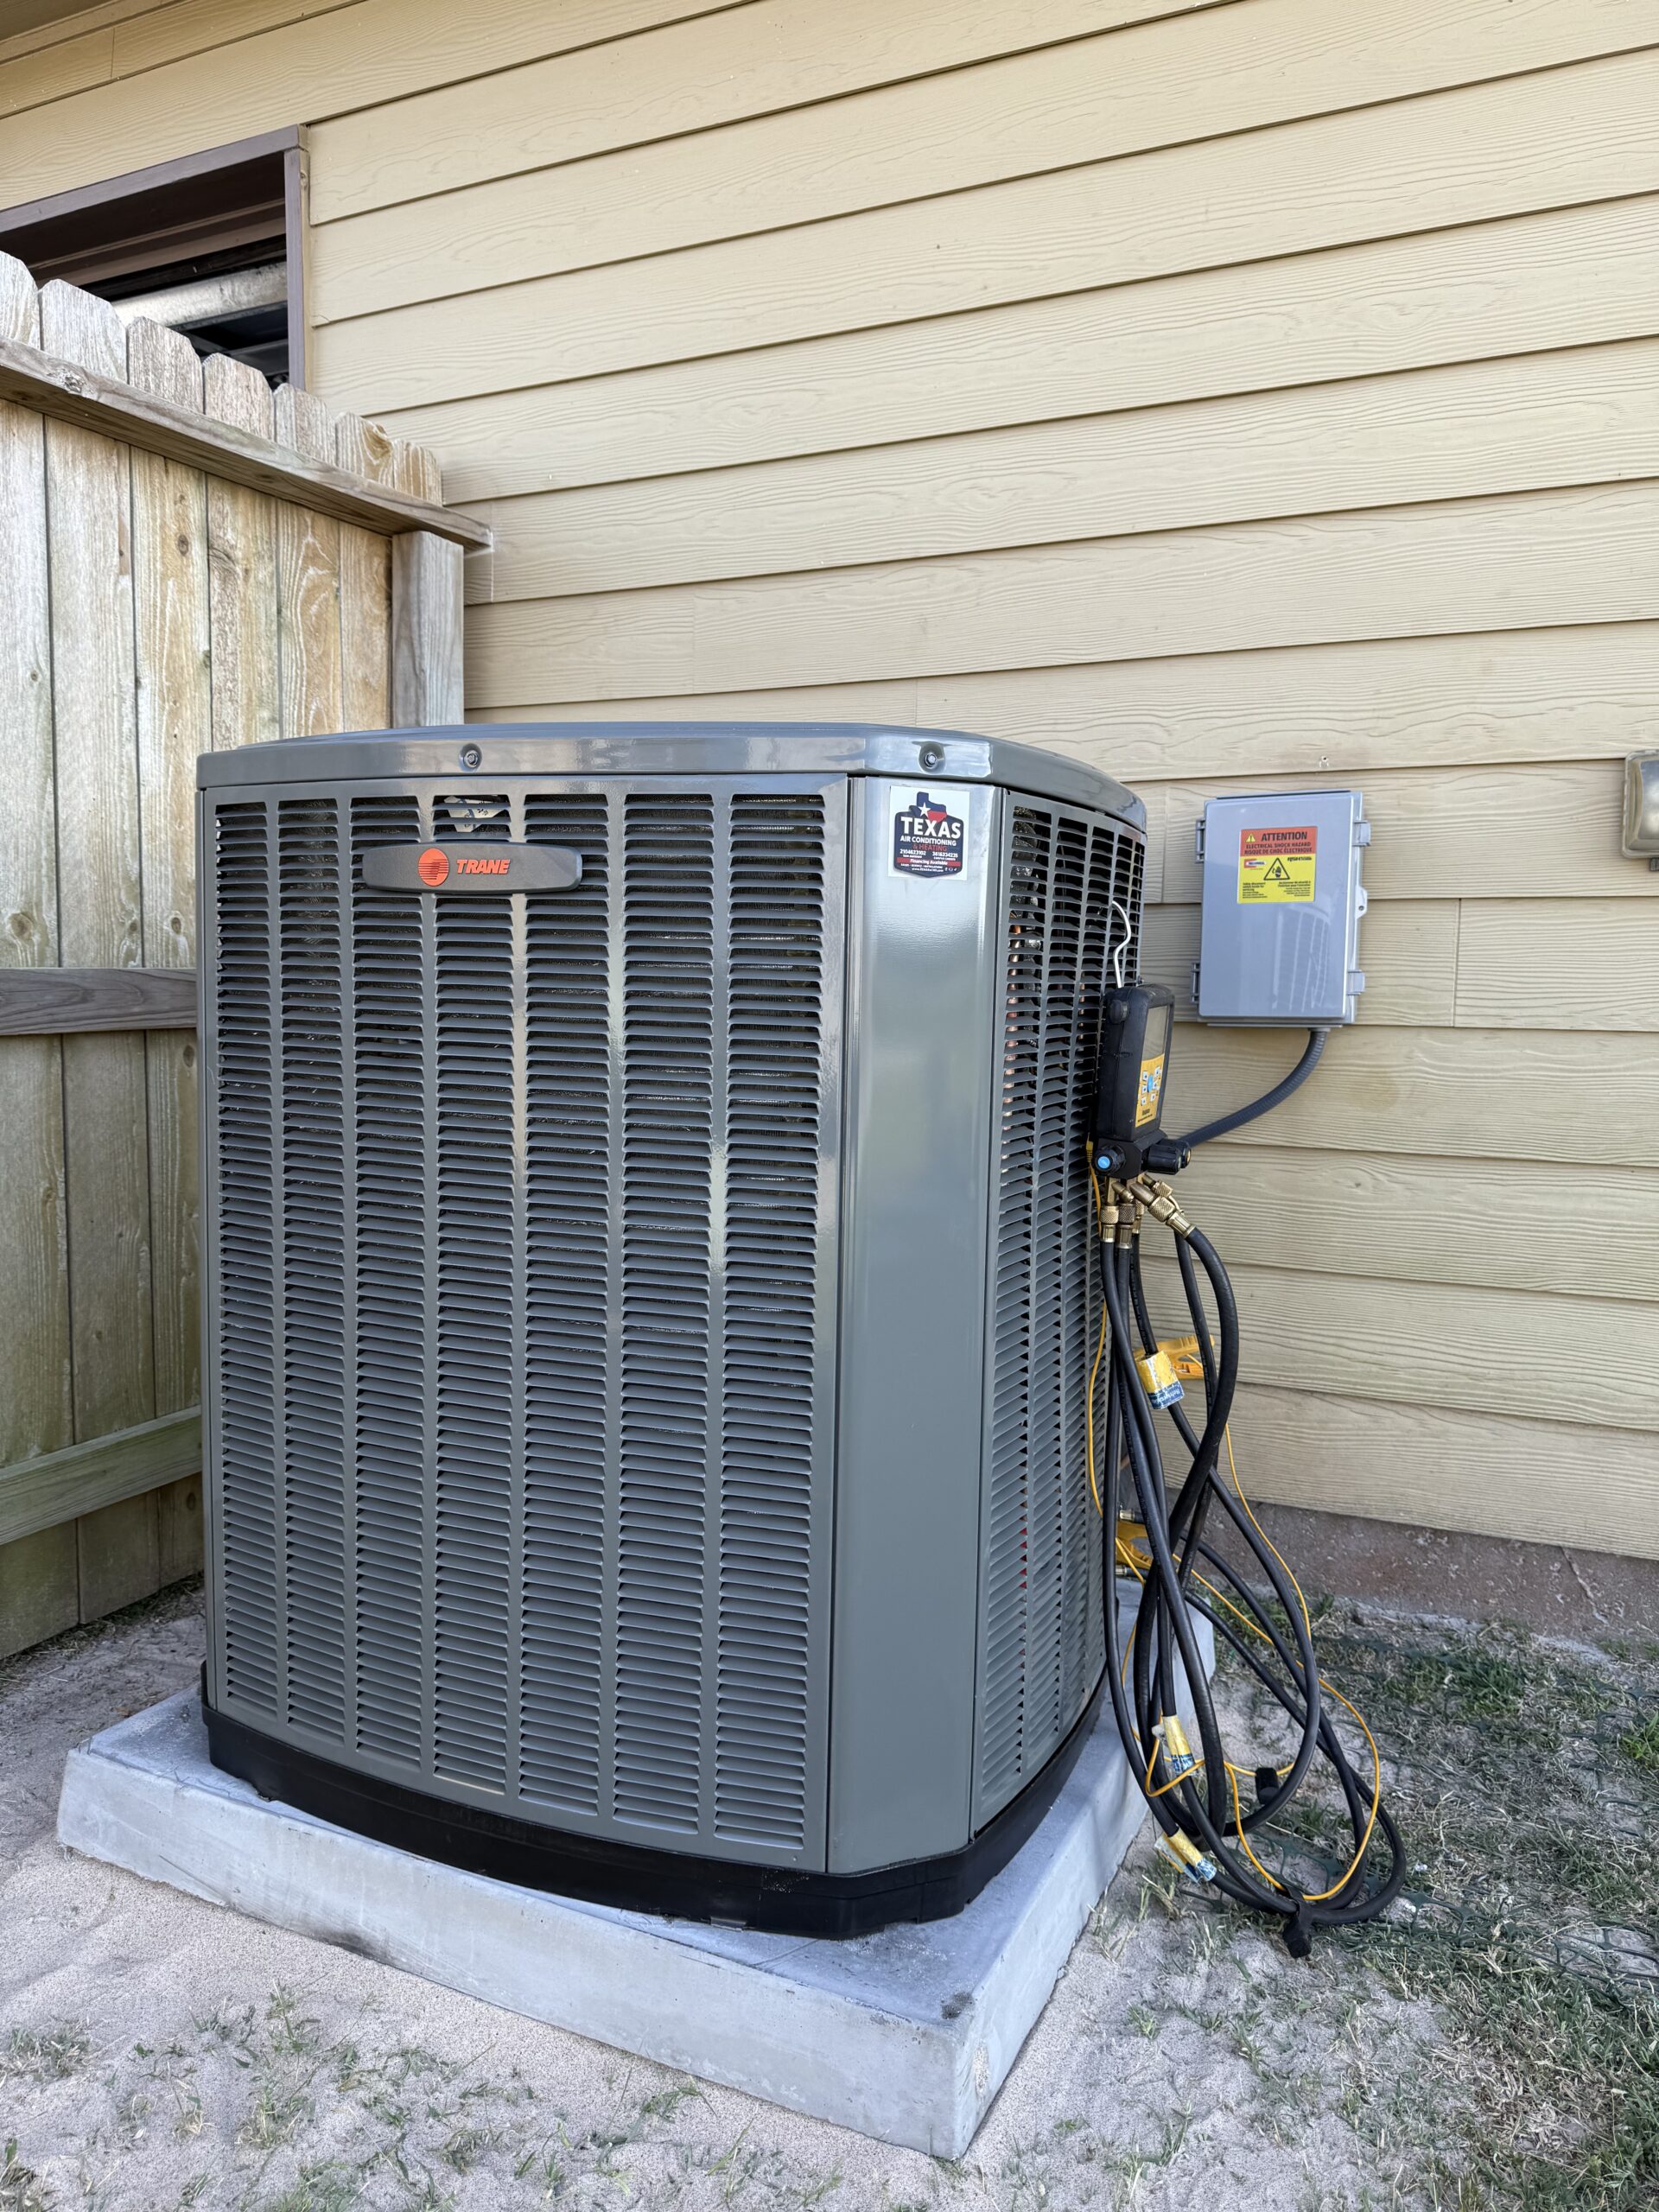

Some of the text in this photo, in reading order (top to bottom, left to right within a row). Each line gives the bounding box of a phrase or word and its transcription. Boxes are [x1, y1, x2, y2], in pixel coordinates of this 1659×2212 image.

[900, 817, 961, 839] TEXAS
[912, 836, 957, 846] CONDITIONING
[1262, 831, 1307, 842] ATTENTION
[918, 843, 947, 852] HEATING
[456, 859, 511, 874] TRANE
